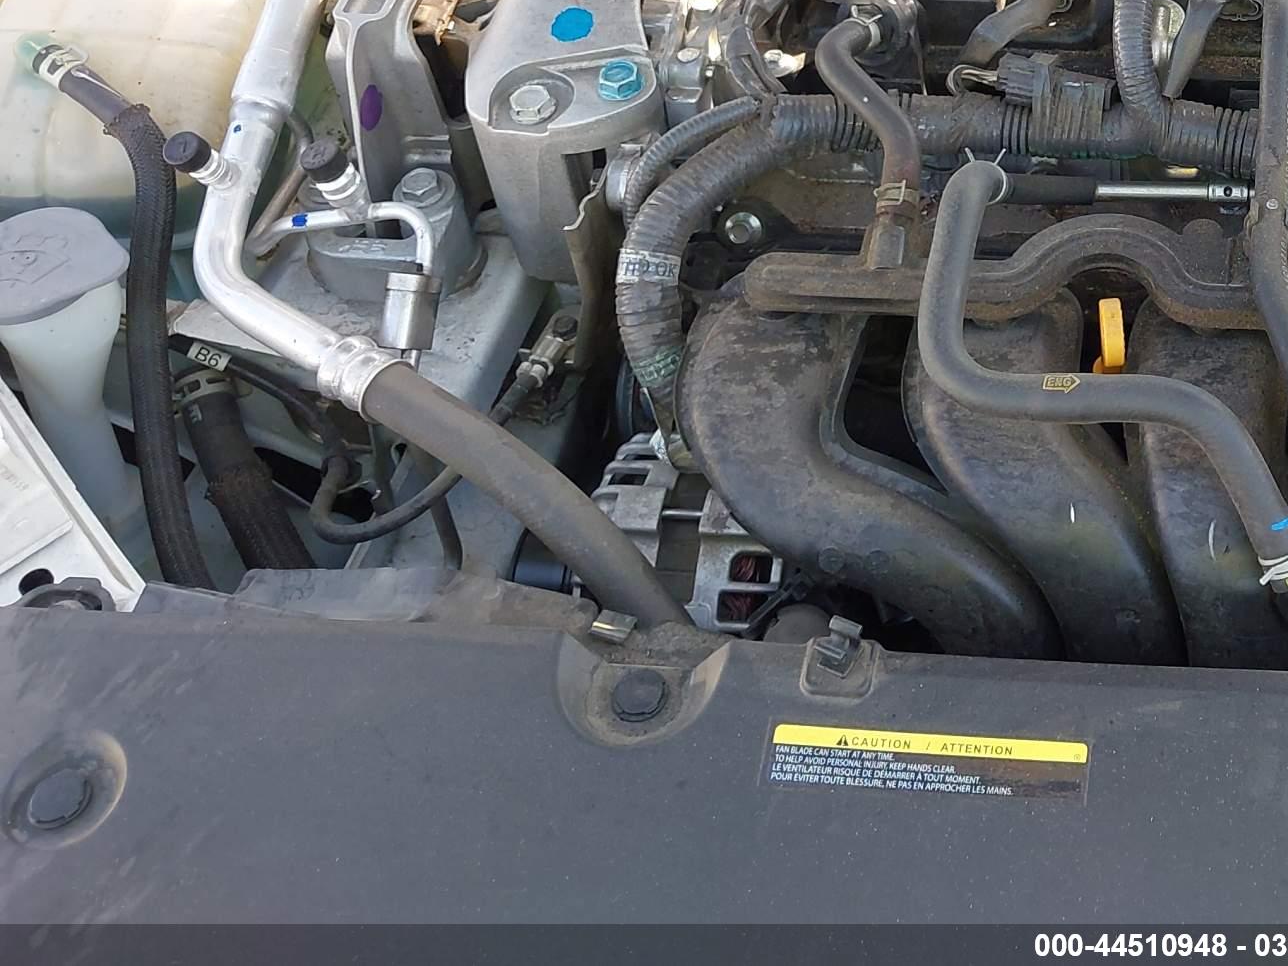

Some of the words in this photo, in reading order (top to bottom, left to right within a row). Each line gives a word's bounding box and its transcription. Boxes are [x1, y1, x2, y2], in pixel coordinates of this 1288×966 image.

[195, 346, 222, 368] B6
[1047, 377, 1072, 387] ENG
[775, 746, 790, 754] FAN
[790, 746, 813, 755] BLADE
[814, 748, 829, 756] CAN
[830, 749, 850, 758] START
[861, 751, 877, 760] ANY
[877, 753, 895, 761] TIME.
[852, 737, 912, 750] CAUTION
[940, 742, 1014, 756] ATTENTION
[772, 763, 782, 772] LE
[782, 764, 832, 775] VENTILATEUR
[833, 766, 860, 777] RISQUE
[861, 769, 873, 778] DE
[923, 773, 944, 782] TOUT
[945, 775, 982, 784] MOMENT.
[775, 754, 785, 762] TO
[785, 755, 803, 764] HELP
[804, 757, 826, 765] AVOID
[827, 758, 862, 768] PERSONAL
[888, 762, 906, 771] KEEP
[907, 764, 931, 773] HANDS
[932, 765, 956, 774] CLEAR.
[771, 772, 793, 781] POUR
[819, 775, 845, 784] TOUTE
[846, 777, 885, 788] BLESSURE,
[886, 780, 897, 789] NE
[897, 781, 912, 790] PAS
[912, 782, 923, 790] EN
[924, 783, 971, 793] APPROCHER
[972, 785, 985, 794] LES
[986, 787, 1014, 795] MAINS.
